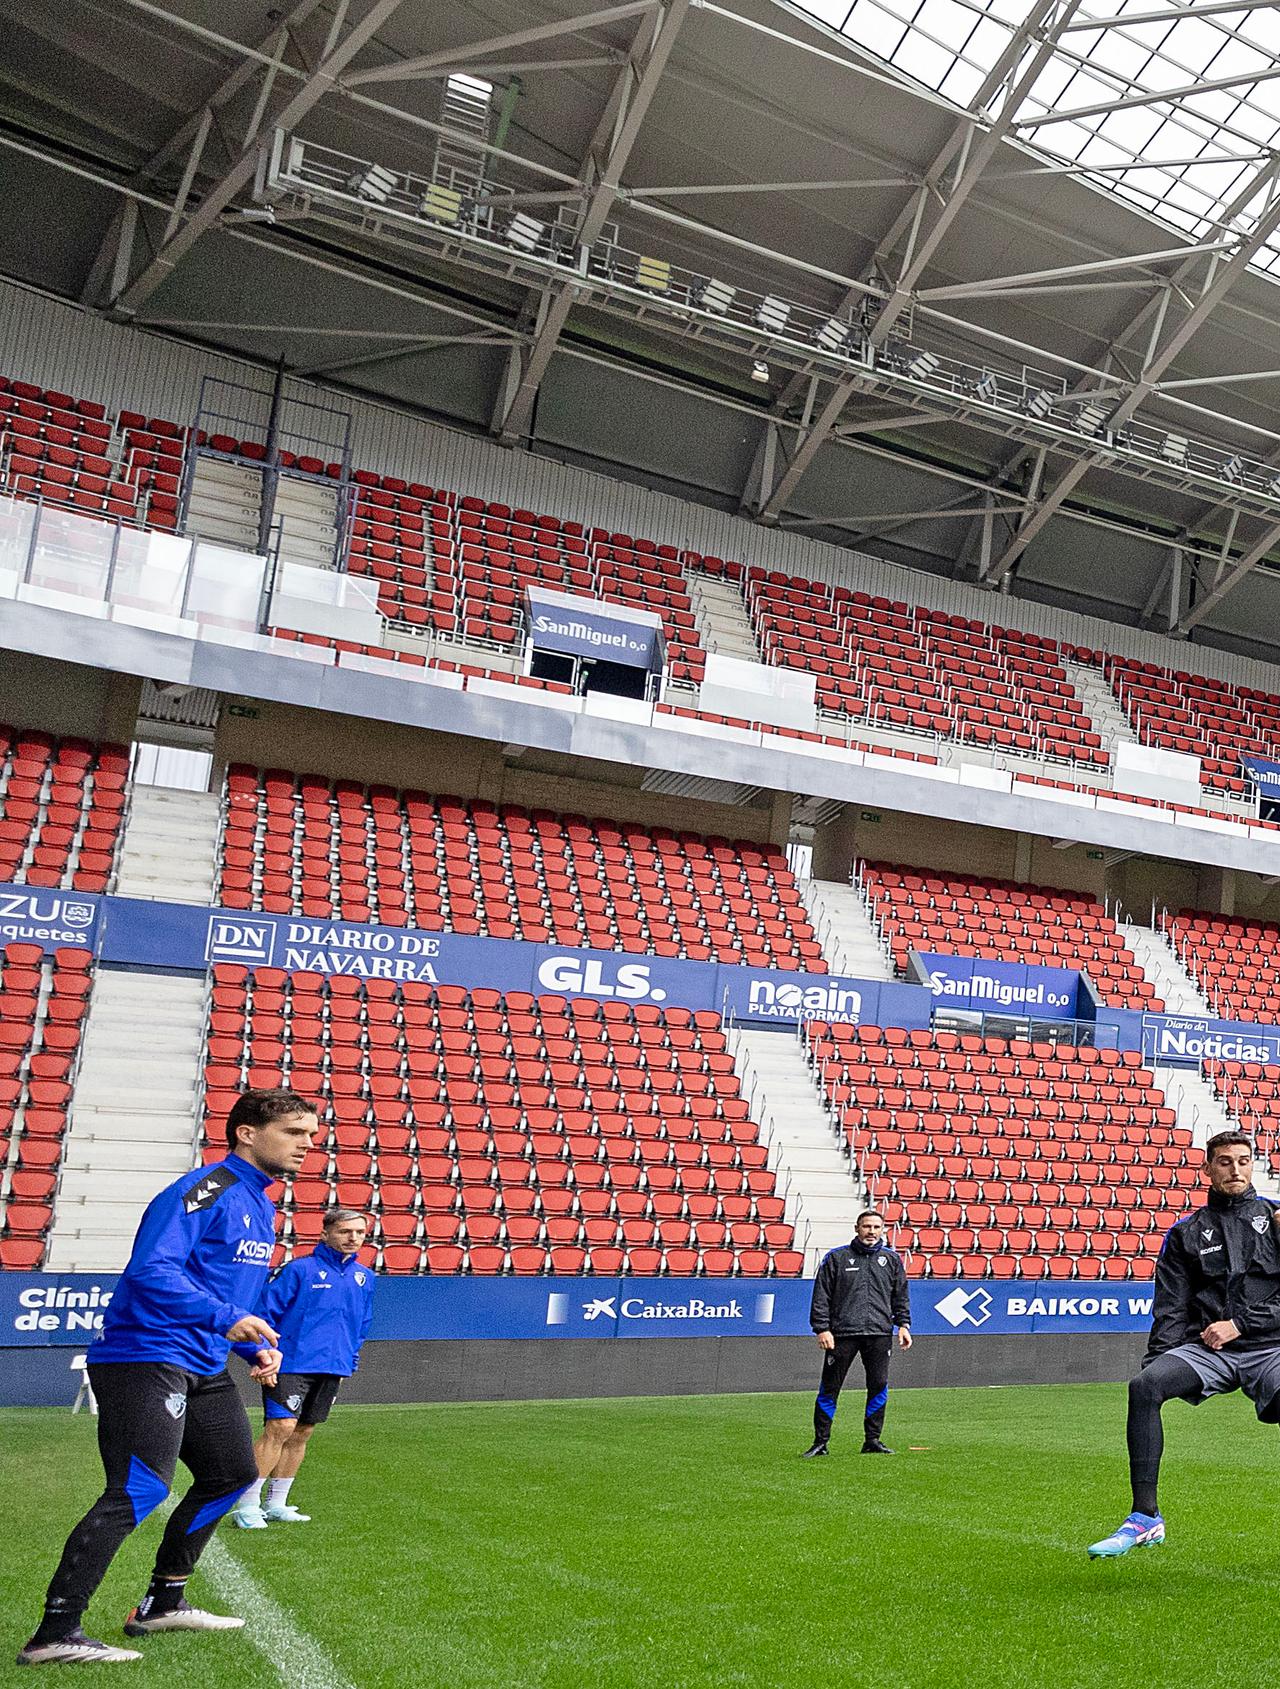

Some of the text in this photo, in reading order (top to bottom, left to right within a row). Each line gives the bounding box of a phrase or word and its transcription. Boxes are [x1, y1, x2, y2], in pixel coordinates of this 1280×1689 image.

[532, 615, 627, 647] SanMiguel
[0, 924, 87, 944] quetes
[214, 923, 265, 949] DN
[286, 922, 440, 957] DIARIO DE
[284, 947, 440, 984] NAVARRA
[538, 955, 667, 1002] GLS.
[926, 971, 1044, 1005] SanMiguel
[748, 1003, 860, 1025] PLATAFORMAS
[1164, 1019, 1205, 1032] Diario de
[1161, 1029, 1270, 1062] Noticias
[19, 1286, 114, 1309] Clínic
[620, 1298, 743, 1321] CaixaBank
[1006, 1298, 1120, 1316] BAIKOR
[15, 1310, 60, 1331] de
